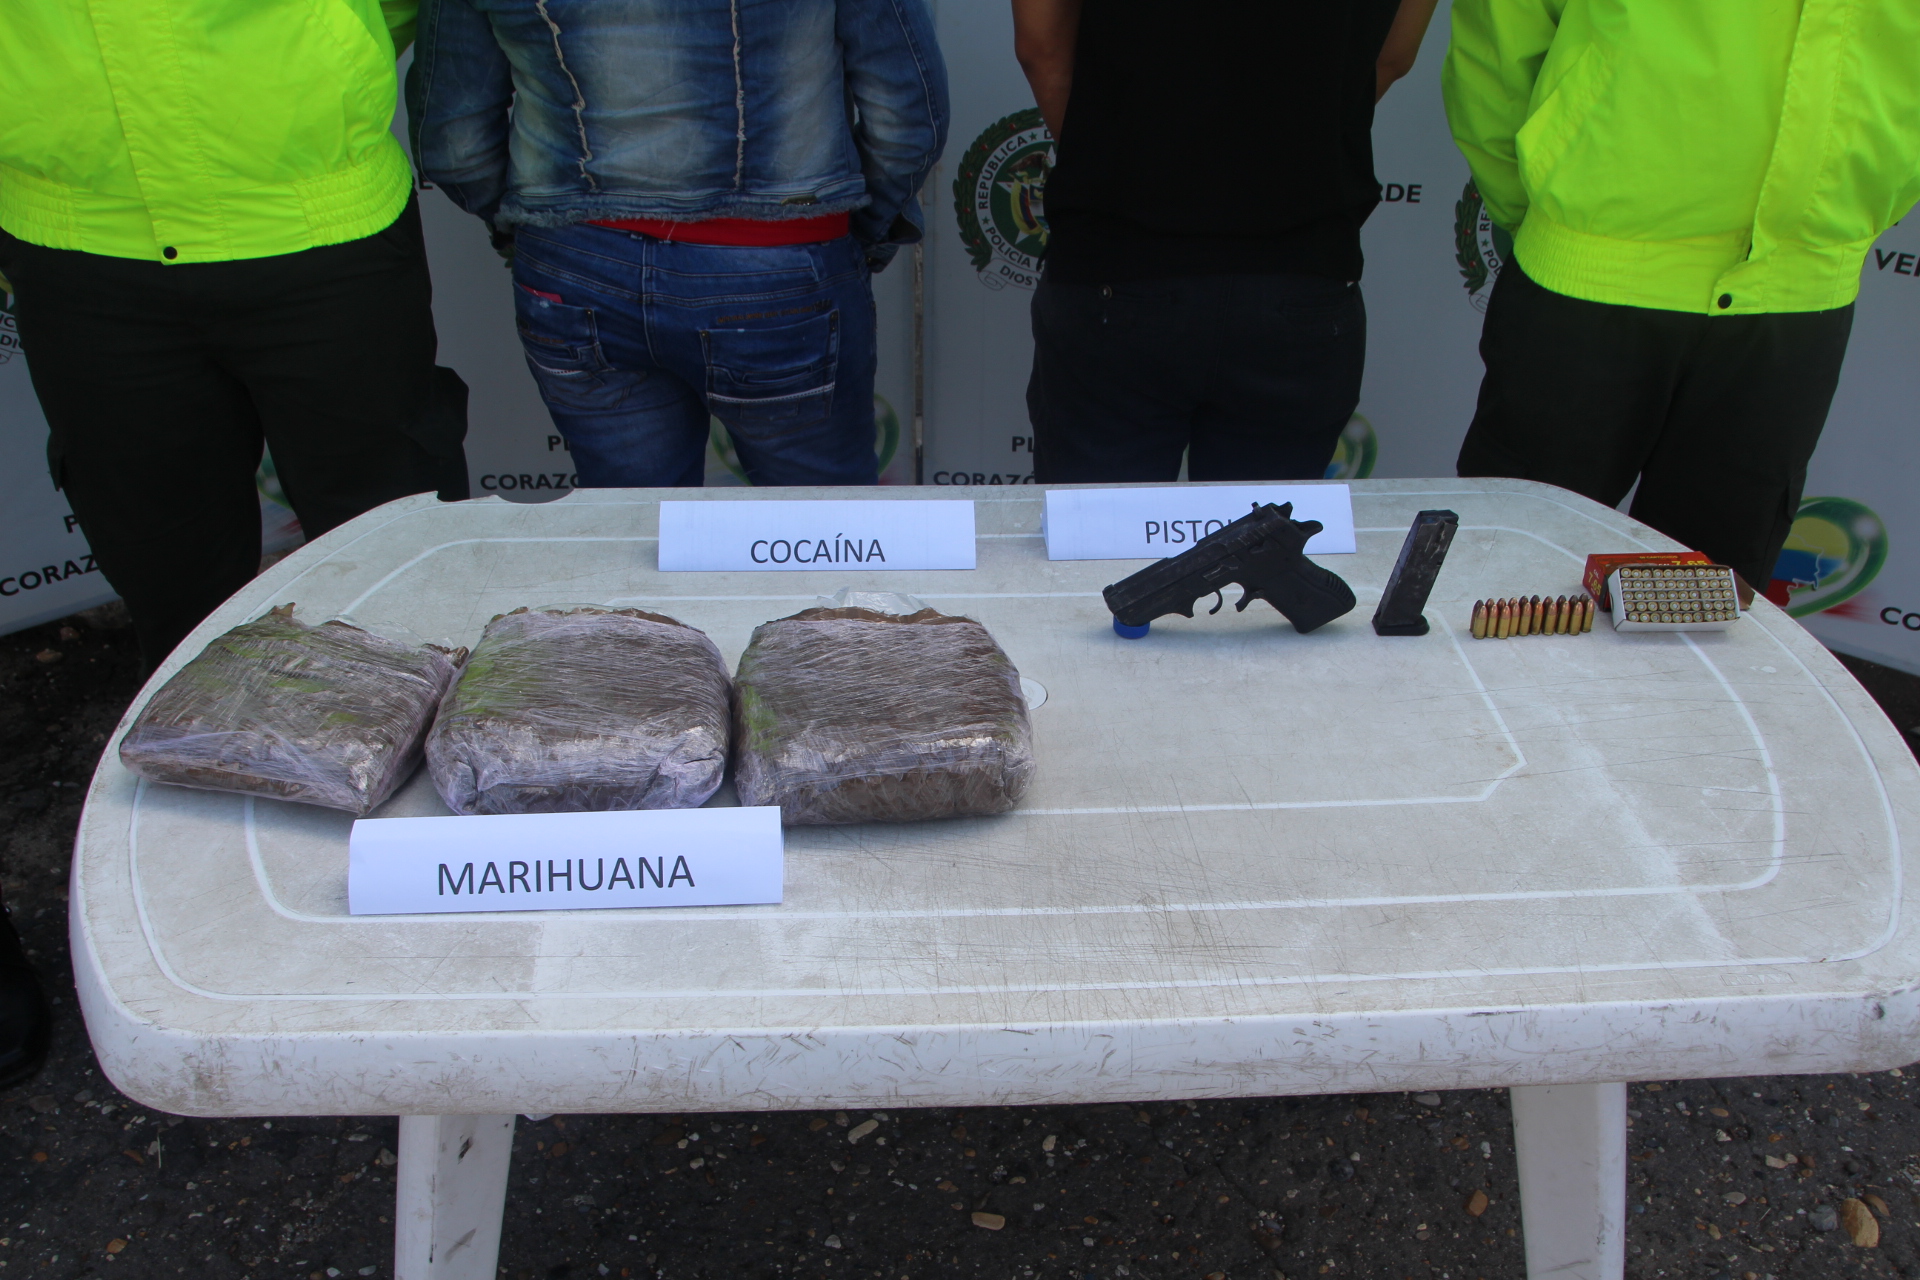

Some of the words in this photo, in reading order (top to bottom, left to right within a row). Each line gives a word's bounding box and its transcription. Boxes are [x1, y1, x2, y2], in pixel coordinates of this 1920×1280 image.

[1000, 264, 1033, 286] DIOS
[1145, 518, 1232, 544] PISTO
[750, 532, 887, 565] COCAÍNA
[437, 855, 696, 896] MARIHUANA
